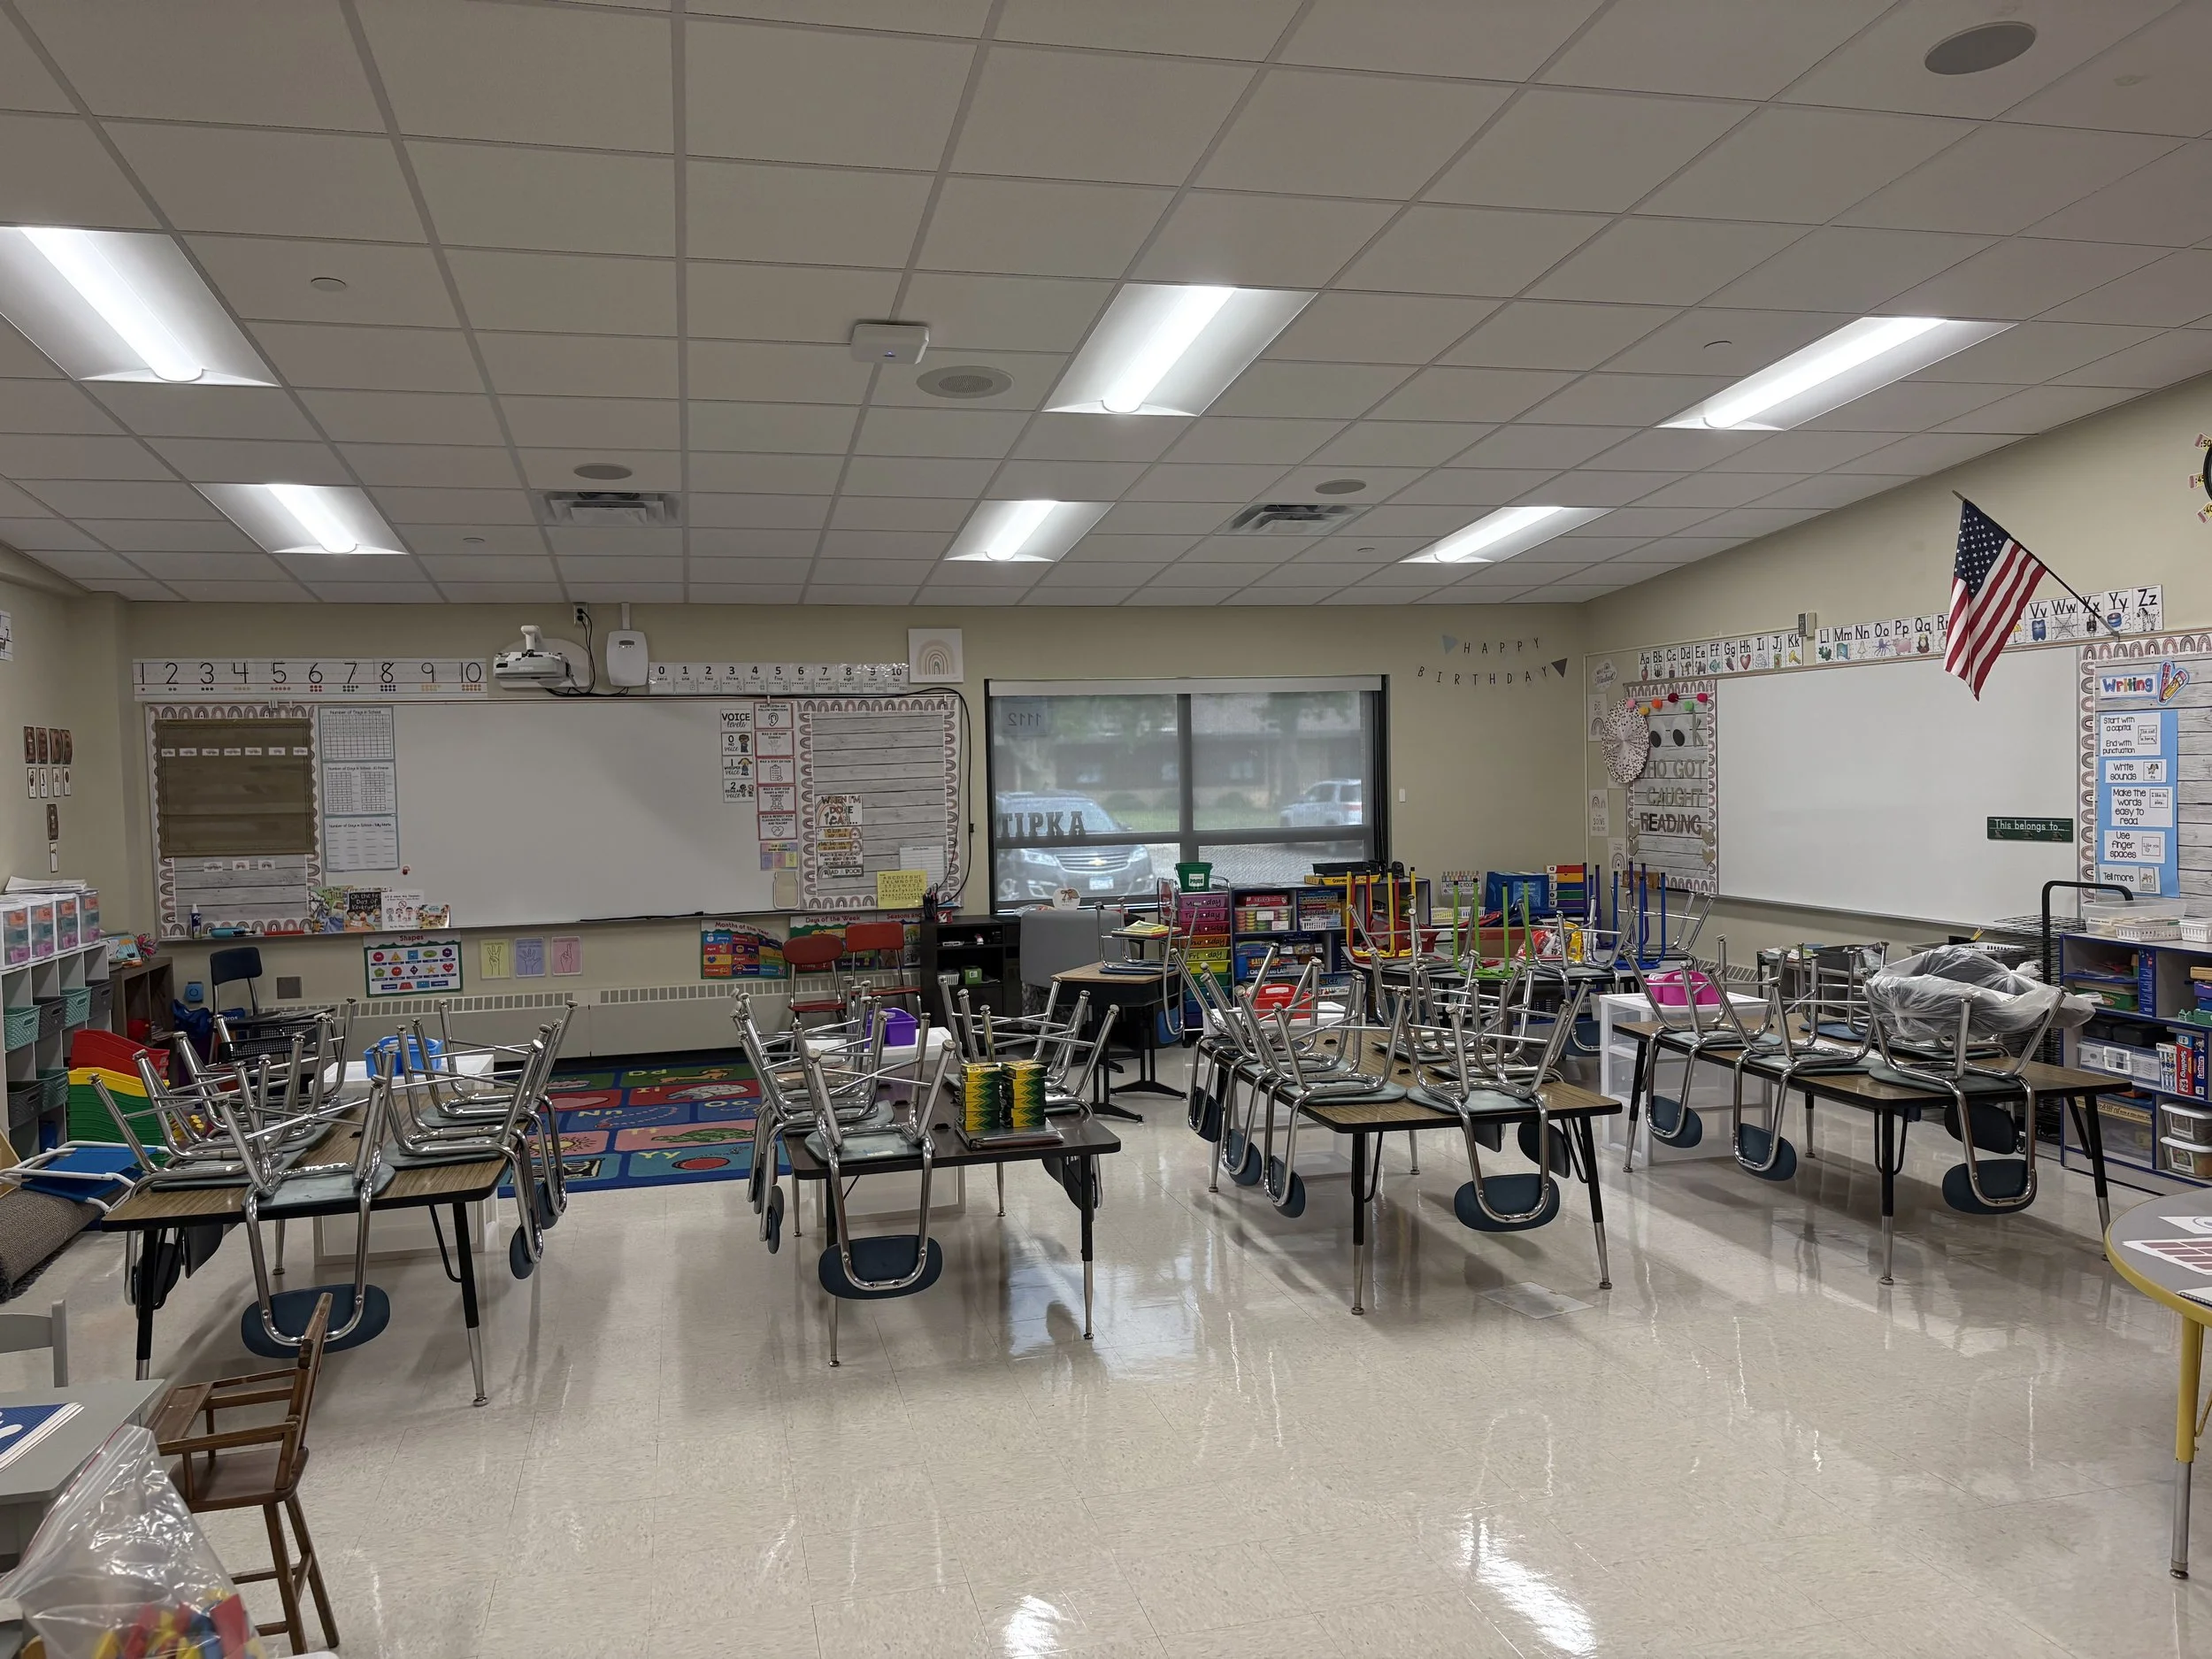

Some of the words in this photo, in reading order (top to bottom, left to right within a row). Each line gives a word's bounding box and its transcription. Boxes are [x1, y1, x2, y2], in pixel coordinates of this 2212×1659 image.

[2200, 439, 2212, 448] :50
[2030, 603, 2047, 618] Vv
[2052, 600, 2076, 615] Ww
[2083, 596, 2101, 613] Xx
[2108, 593, 2127, 612] Yy
[2139, 588, 2157, 607] Zz
[1834, 628, 1852, 641] Mm
[1855, 626, 1870, 640] Nn
[1875, 623, 1889, 637] Oo
[1895, 620, 1909, 637] Pp
[1916, 618, 1932, 634] Qq
[1463, 637, 1539, 653] HAPPY
[1640, 653, 1649, 664] Aa
[1654, 651, 1663, 663] Bb
[1666, 649, 1676, 661] Cc
[1680, 647, 1690, 659] Dd
[1695, 646, 1705, 658] Ee
[1710, 644, 1719, 657] Ff
[1724, 641, 1735, 657] Gg
[1740, 641, 1750, 653] Hh
[1757, 638, 1764, 650] Ii
[1772, 636, 1783, 652] Jj
[1788, 634, 1800, 648] Kk
[165, 663, 179, 684] 2
[200, 663, 214, 684] 3
[234, 663, 249, 684] 4
[273, 663, 287, 684] 5
[309, 663, 323, 683] 6
[344, 663, 357, 684] 7
[381, 663, 394, 683] 8
[421, 663, 434, 683] 9
[460, 663, 481, 683] 10
[775, 666, 781, 675] 5
[798, 666, 804, 675] 6
[891, 667, 902, 676] 10
[1417, 665, 1547, 685] BIRTHDAY
[2102, 678, 2153, 692] Writing
[1673, 759, 1705, 779] GOT
[1647, 787, 1702, 806] CAUGHT
[2116, 808, 2133, 817] easy
[996, 810, 1087, 837] TIPKA
[1640, 812, 1701, 834] READING
[1994, 819, 2011, 829] This
[2015, 819, 2046, 833] belongs
[2112, 841, 2135, 850] finger
